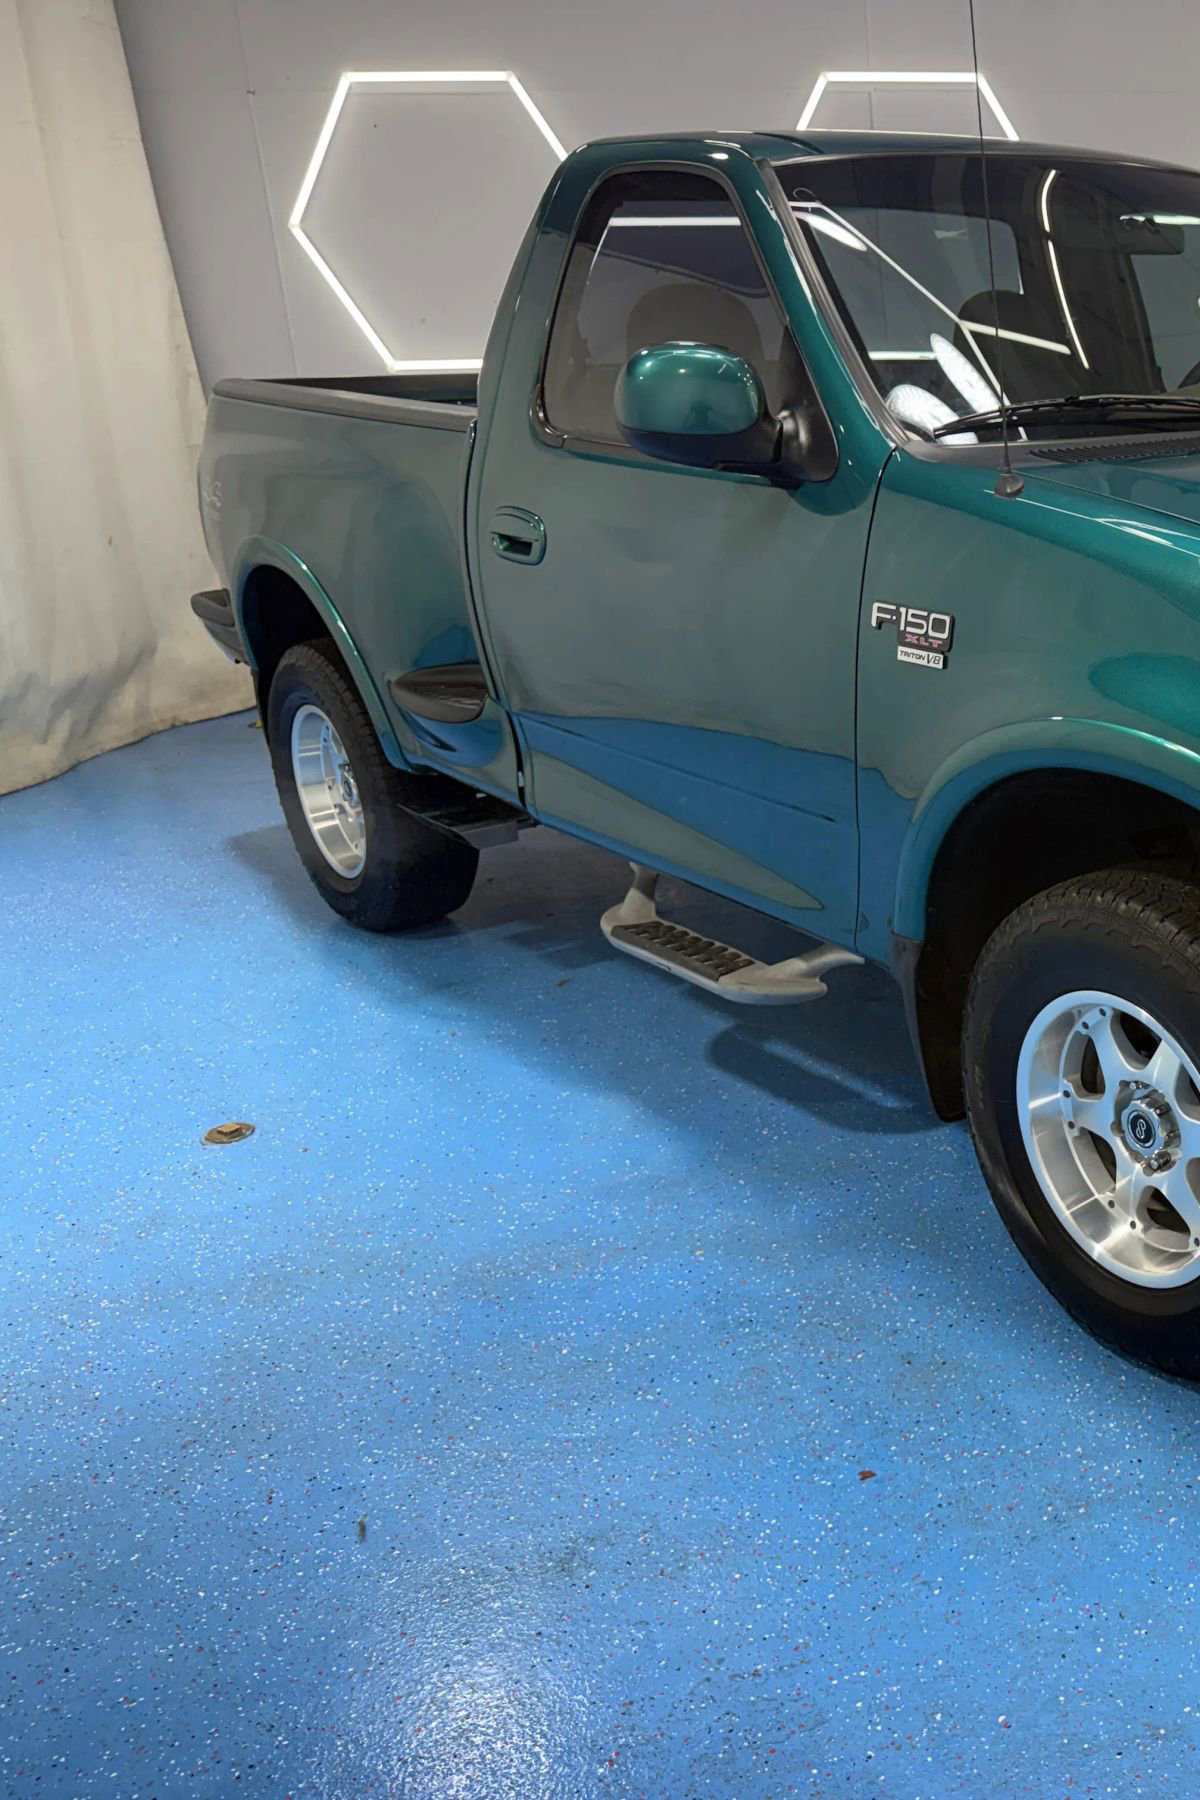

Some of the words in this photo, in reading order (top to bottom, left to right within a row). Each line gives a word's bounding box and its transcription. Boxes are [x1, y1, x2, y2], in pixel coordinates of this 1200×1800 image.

[871, 602, 950, 639] F-150
[904, 633, 943, 648] XLT
[899, 649, 926, 661] TRITON
[926, 653, 942, 665] V8
